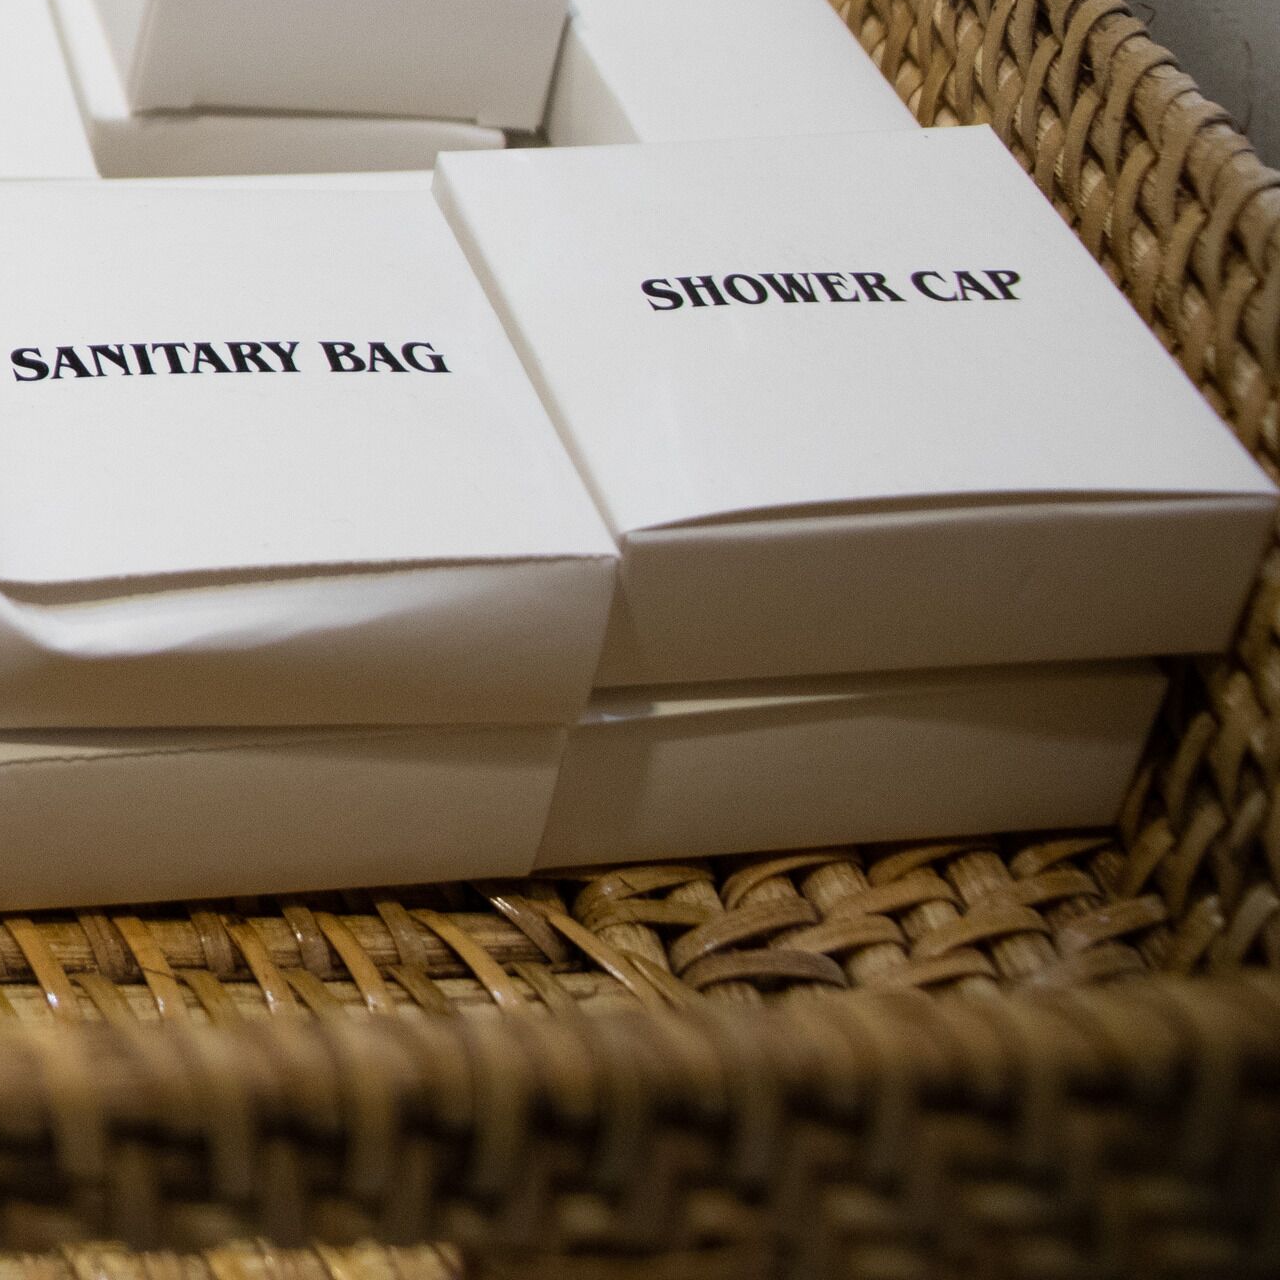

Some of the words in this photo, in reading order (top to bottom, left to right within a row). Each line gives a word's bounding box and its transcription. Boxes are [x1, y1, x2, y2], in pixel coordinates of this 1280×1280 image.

[641, 271, 907, 312] SHOWER
[909, 269, 1022, 303] CAP
[10, 341, 300, 382] SANITARY
[320, 341, 451, 374] BAG
